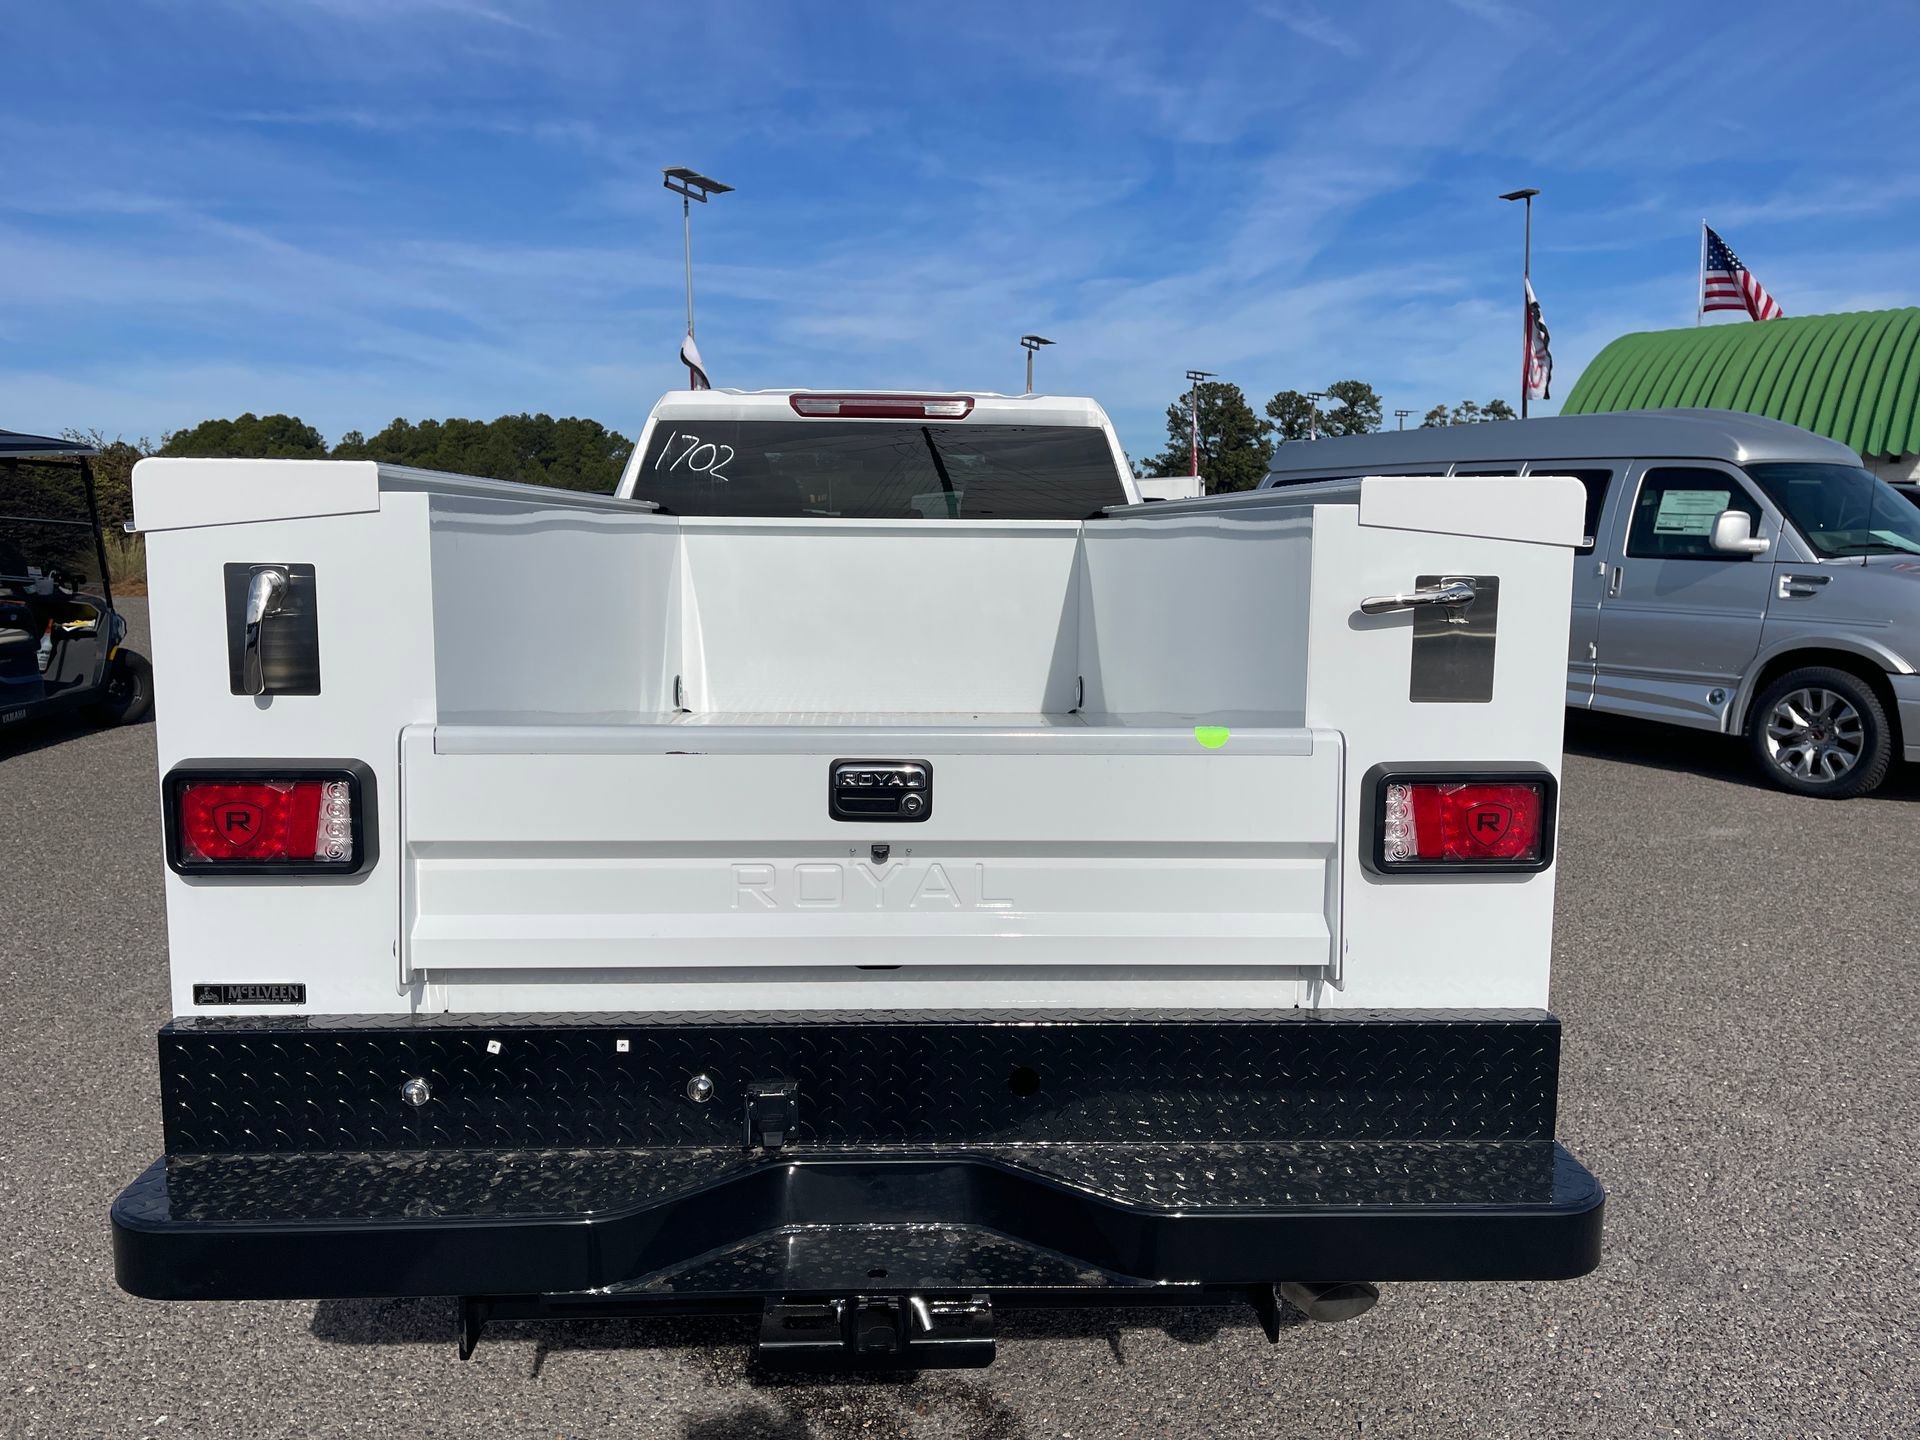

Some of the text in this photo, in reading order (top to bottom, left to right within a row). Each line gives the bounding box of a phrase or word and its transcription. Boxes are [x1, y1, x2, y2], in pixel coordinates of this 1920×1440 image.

[655, 430, 734, 482] 1702
[2, 708, 26, 723] YAMAHA
[842, 771, 919, 786] ROYAL
[226, 811, 251, 832] R
[1477, 812, 1500, 832] R
[730, 863, 1015, 908] ROYAL
